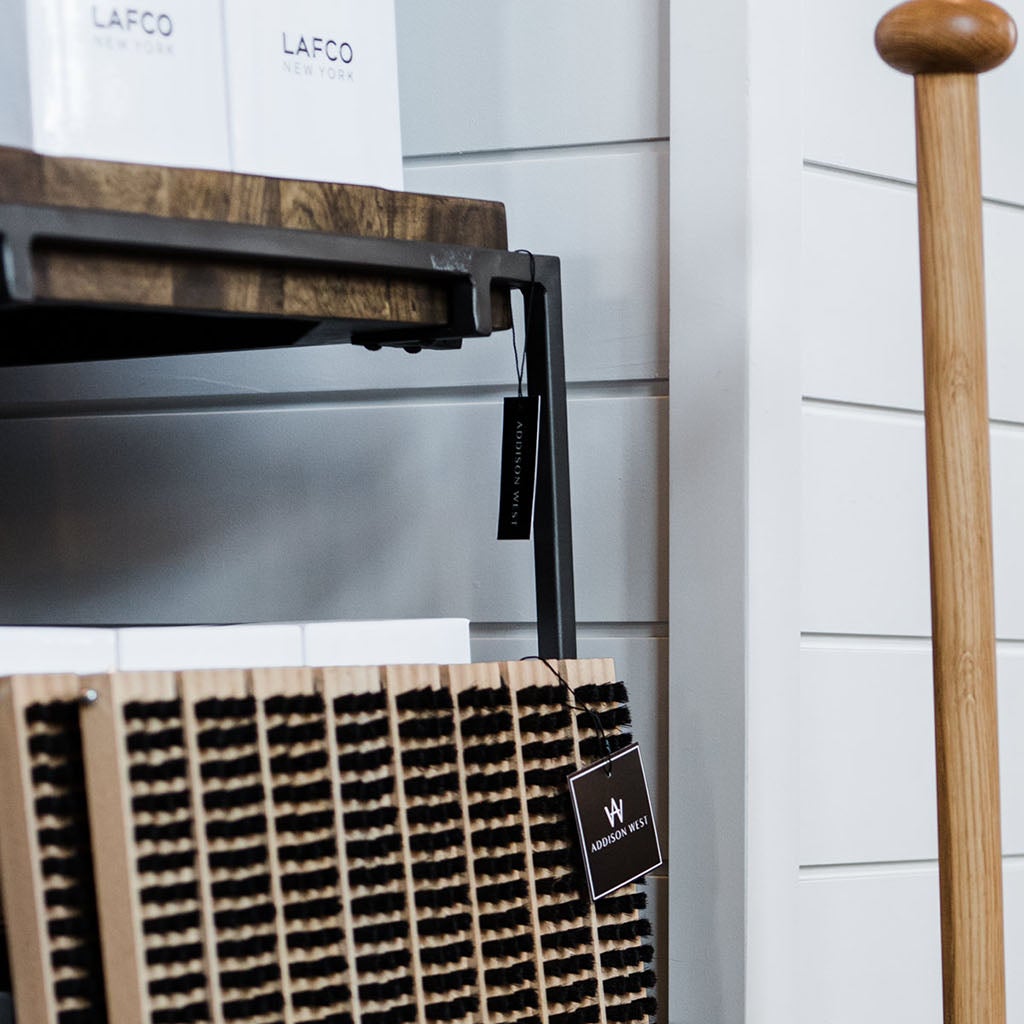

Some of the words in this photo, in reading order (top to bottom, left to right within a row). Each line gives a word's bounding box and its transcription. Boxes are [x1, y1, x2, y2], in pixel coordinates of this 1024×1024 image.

[93, 6, 173, 37] LAFCO
[282, 32, 354, 64] LAFCO
[282, 61, 313, 76] NEW
[318, 67, 355, 83] YORK
[514, 421, 523, 485] ADDISON
[591, 828, 628, 853] ADDISON
[628, 815, 649, 833] WEST
